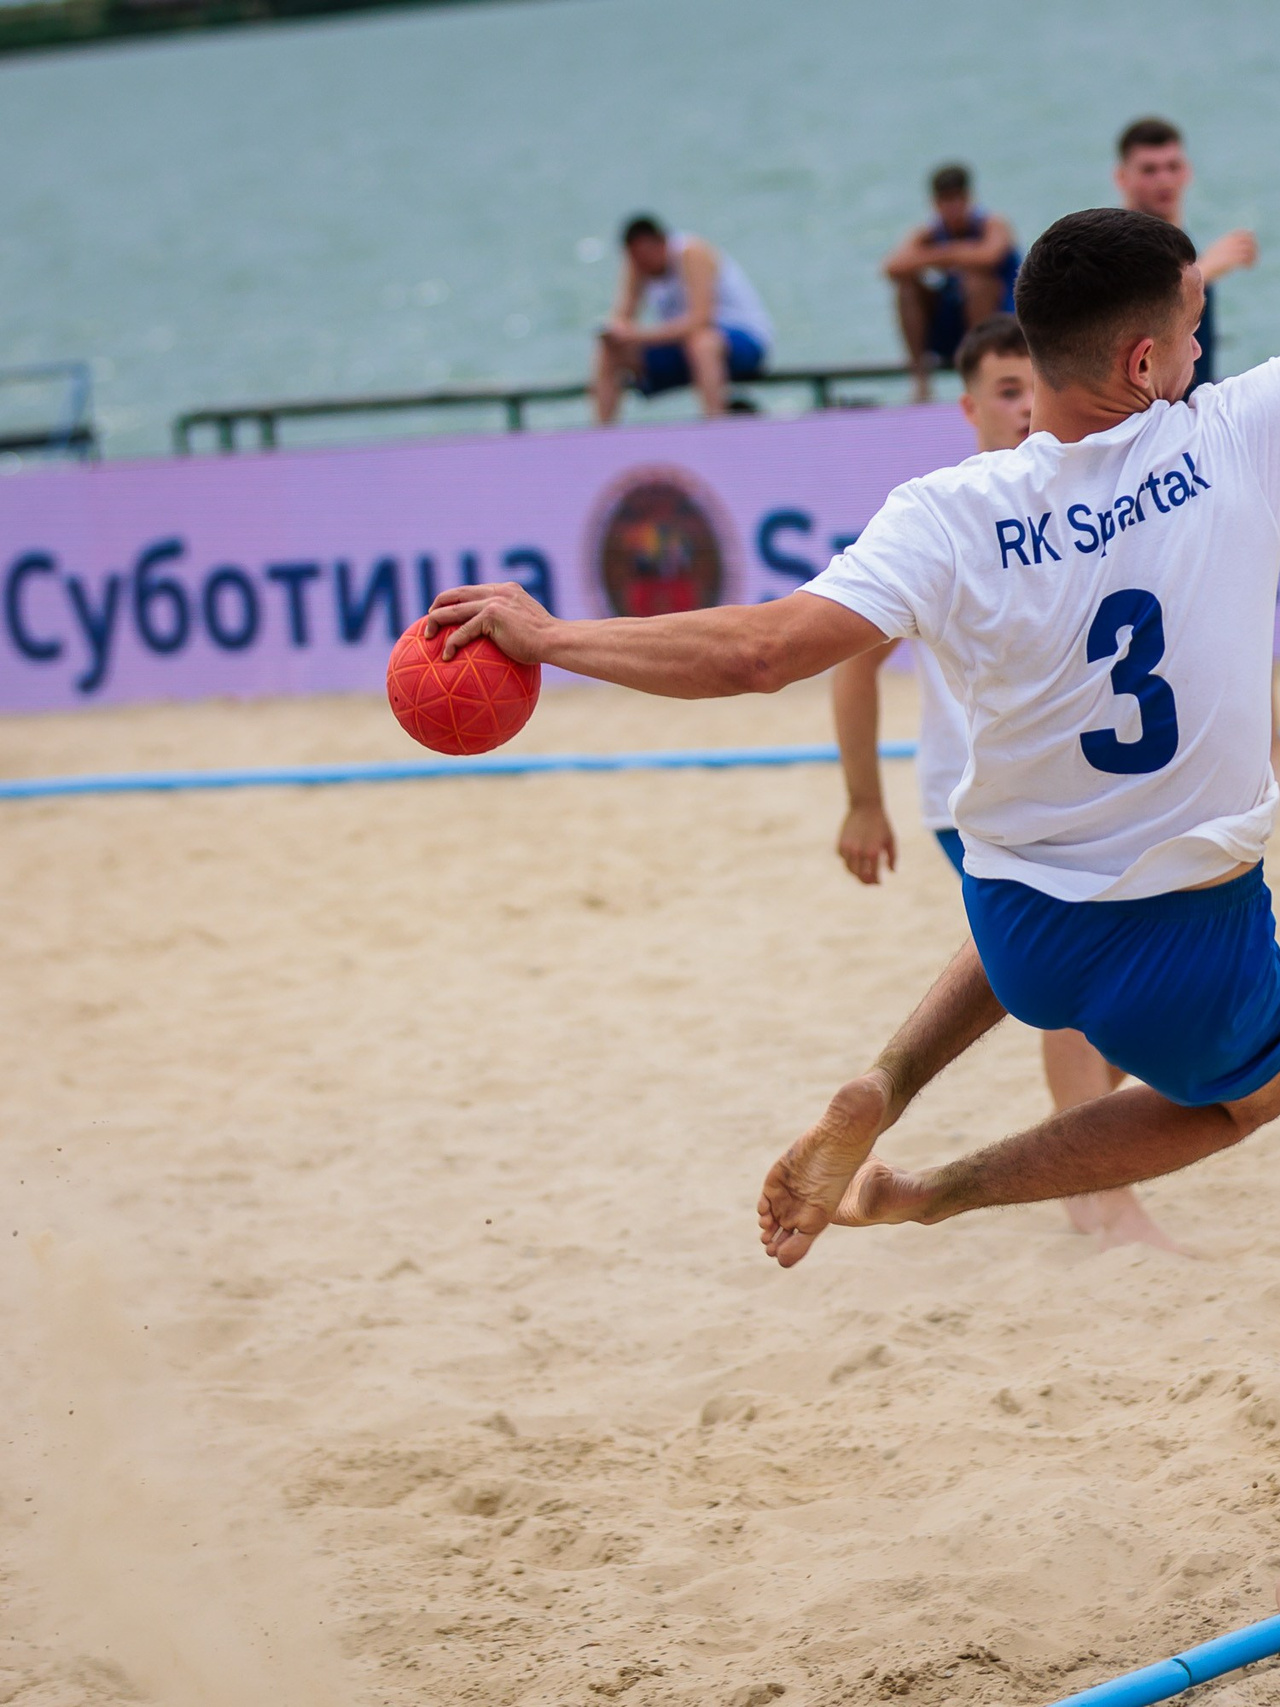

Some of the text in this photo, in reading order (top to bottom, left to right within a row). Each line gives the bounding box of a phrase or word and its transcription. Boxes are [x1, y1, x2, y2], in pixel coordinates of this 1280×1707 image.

[995, 512, 1062, 569] RK
[1067, 452, 1211, 558] Spartak
[1079, 588, 1179, 775] 3
